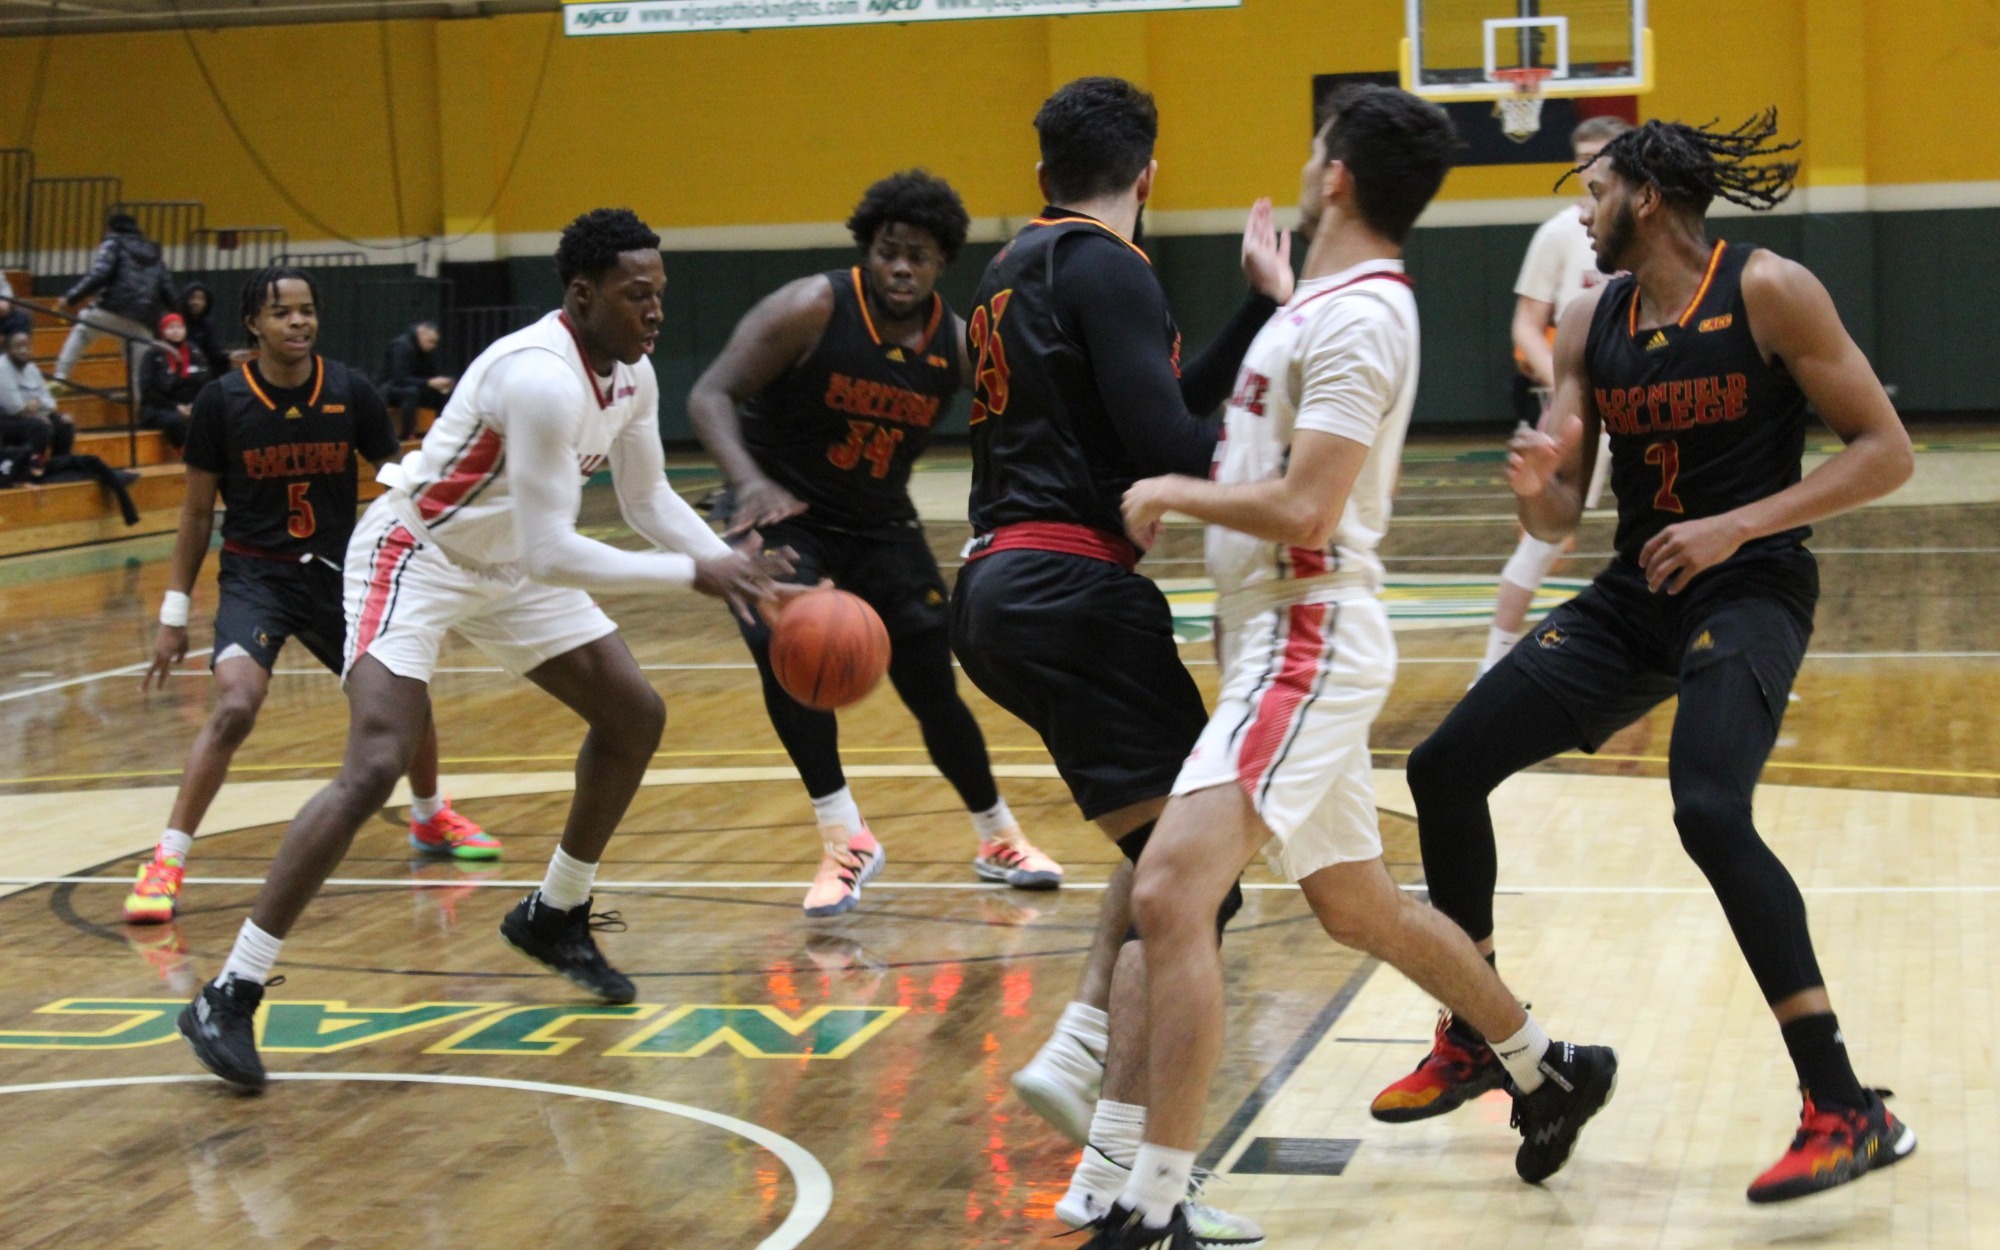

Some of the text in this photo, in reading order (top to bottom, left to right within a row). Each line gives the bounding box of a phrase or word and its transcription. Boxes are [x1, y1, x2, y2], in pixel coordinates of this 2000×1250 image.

[575, 8, 628, 28] NJCU
[826, 418, 905, 479] 34
[1644, 439, 1684, 514] 2
[287, 482, 316, 538] 5
